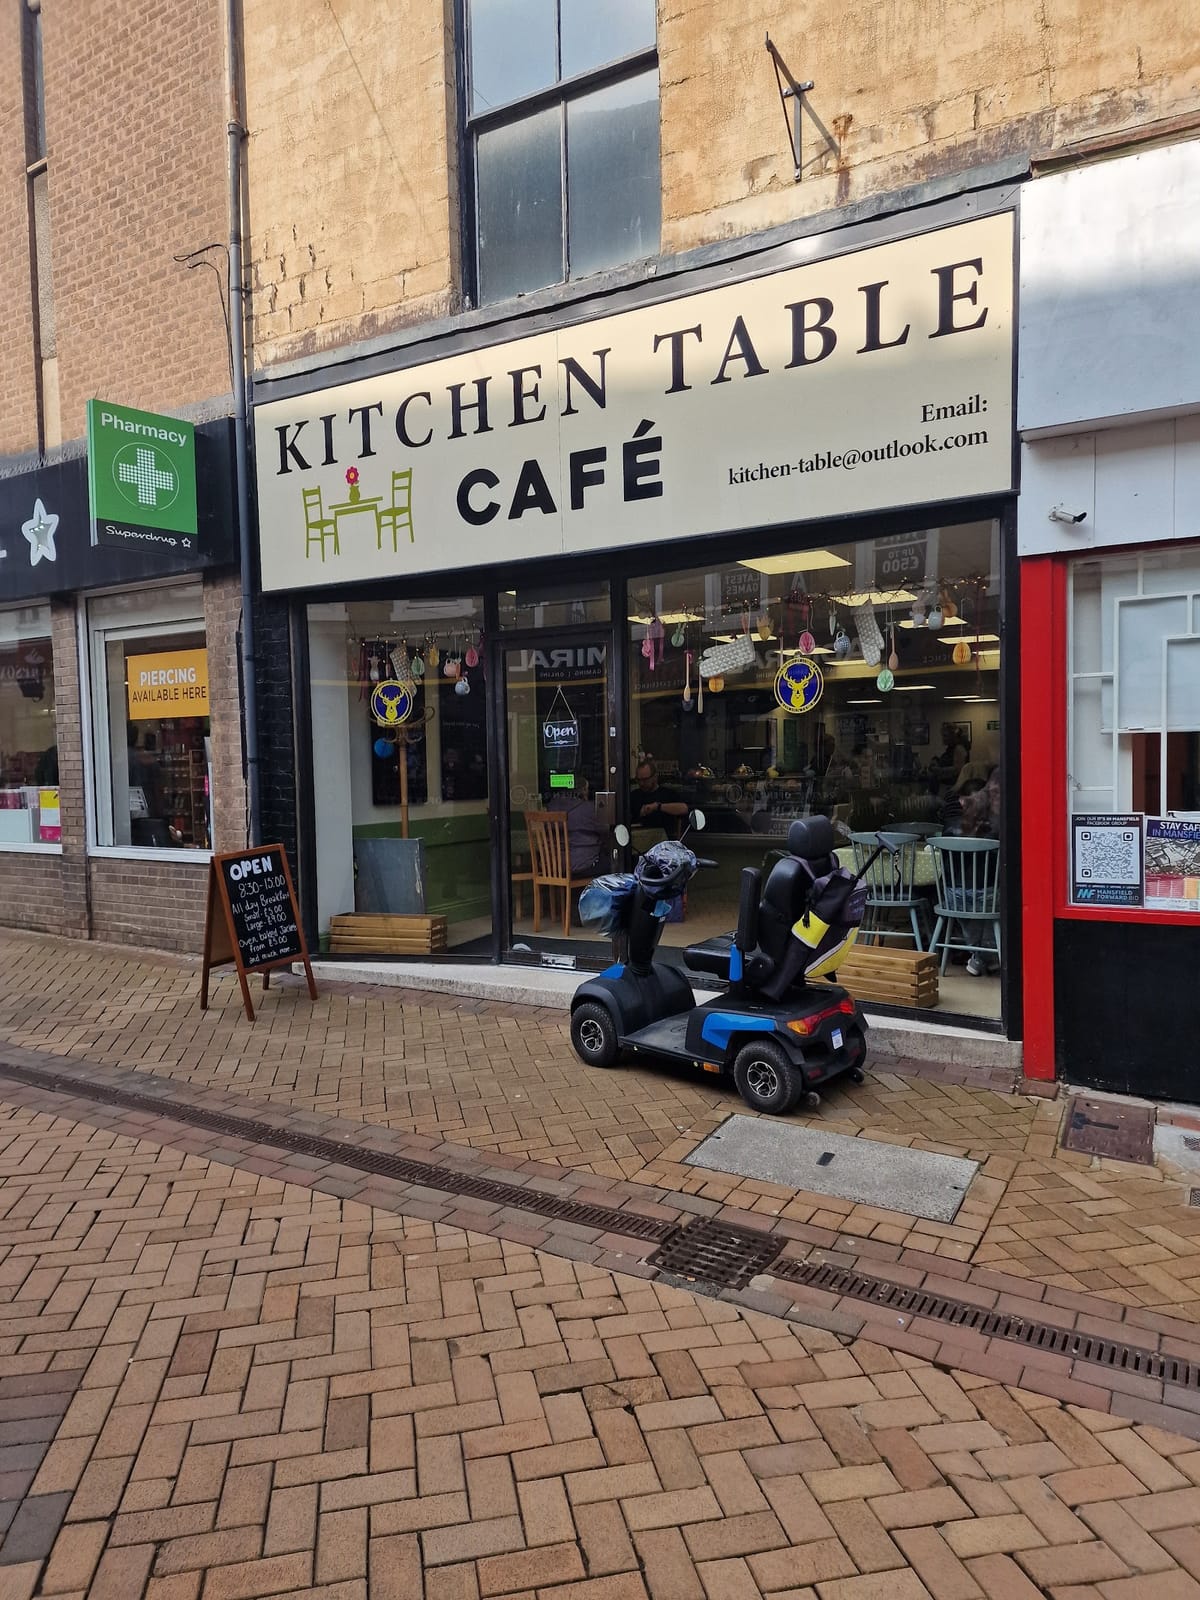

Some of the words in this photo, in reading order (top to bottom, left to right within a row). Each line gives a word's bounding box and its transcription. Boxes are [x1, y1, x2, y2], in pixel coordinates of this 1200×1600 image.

[274, 348, 611, 475] KITCHEN
[653, 258, 988, 394] TABLE
[920, 394, 988, 423] Email:
[101, 412, 187, 447] Pharmacy
[728, 430, 989, 485] kitchen-table@outlook.com
[456, 419, 663, 526] CAFÉ
[105, 525, 178, 546] Superdrug
[140, 667, 196, 687] PIERCING
[132, 687, 179, 703] AVAILABLE
[183, 686, 207, 699] HERE
[545, 724, 576, 741] Open
[1152, 829, 1161, 837] IN
[1163, 830, 1200, 839] MANSFIE
[1160, 821, 1182, 830] STAY
[1183, 823, 1200, 832] SAF
[230, 855, 272, 880] OPEN
[232, 902, 244, 914] All
[245, 900, 259, 914] day
[259, 927, 278, 941] baked
